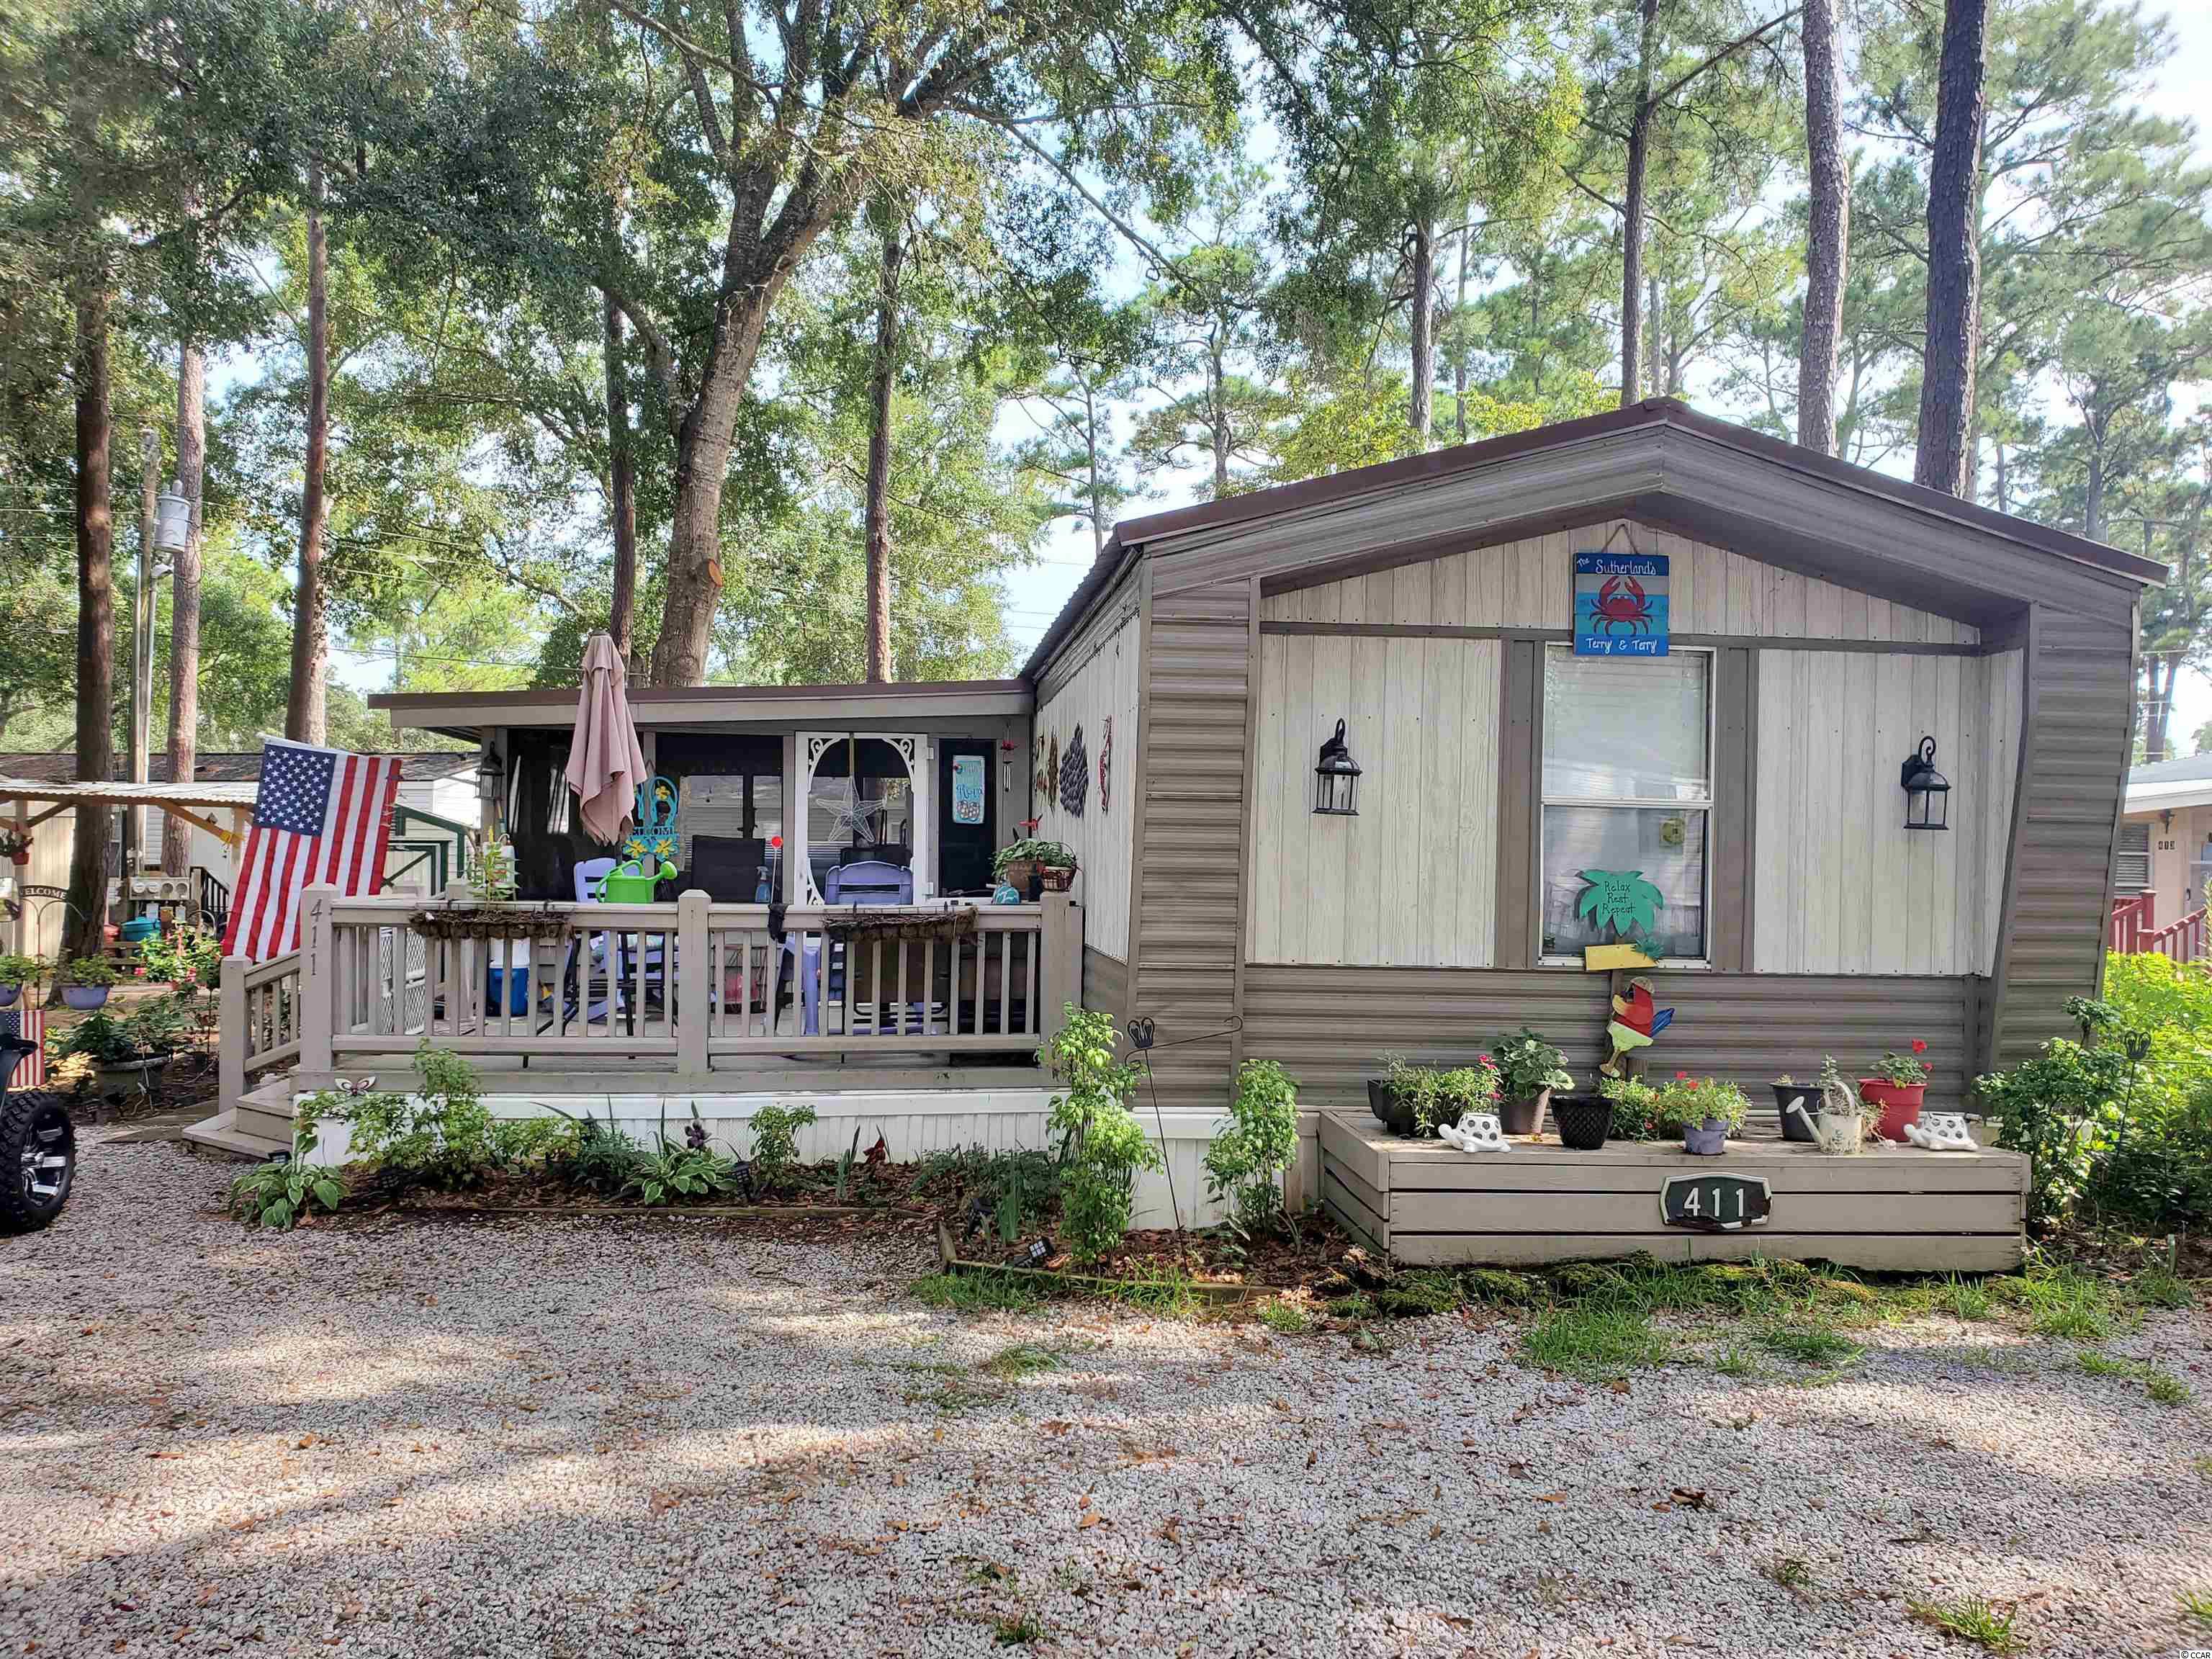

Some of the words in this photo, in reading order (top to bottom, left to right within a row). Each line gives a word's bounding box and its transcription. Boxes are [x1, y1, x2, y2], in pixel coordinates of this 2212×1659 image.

[1585, 638, 1613, 654] Terry
[1619, 639, 1628, 650] &
[1604, 881, 1631, 892] Relax
[1607, 892, 1629, 903] Rest
[1601, 903, 1637, 916] Repeat
[310, 898, 323, 976] 411
[1683, 1187, 1745, 1217] 411
